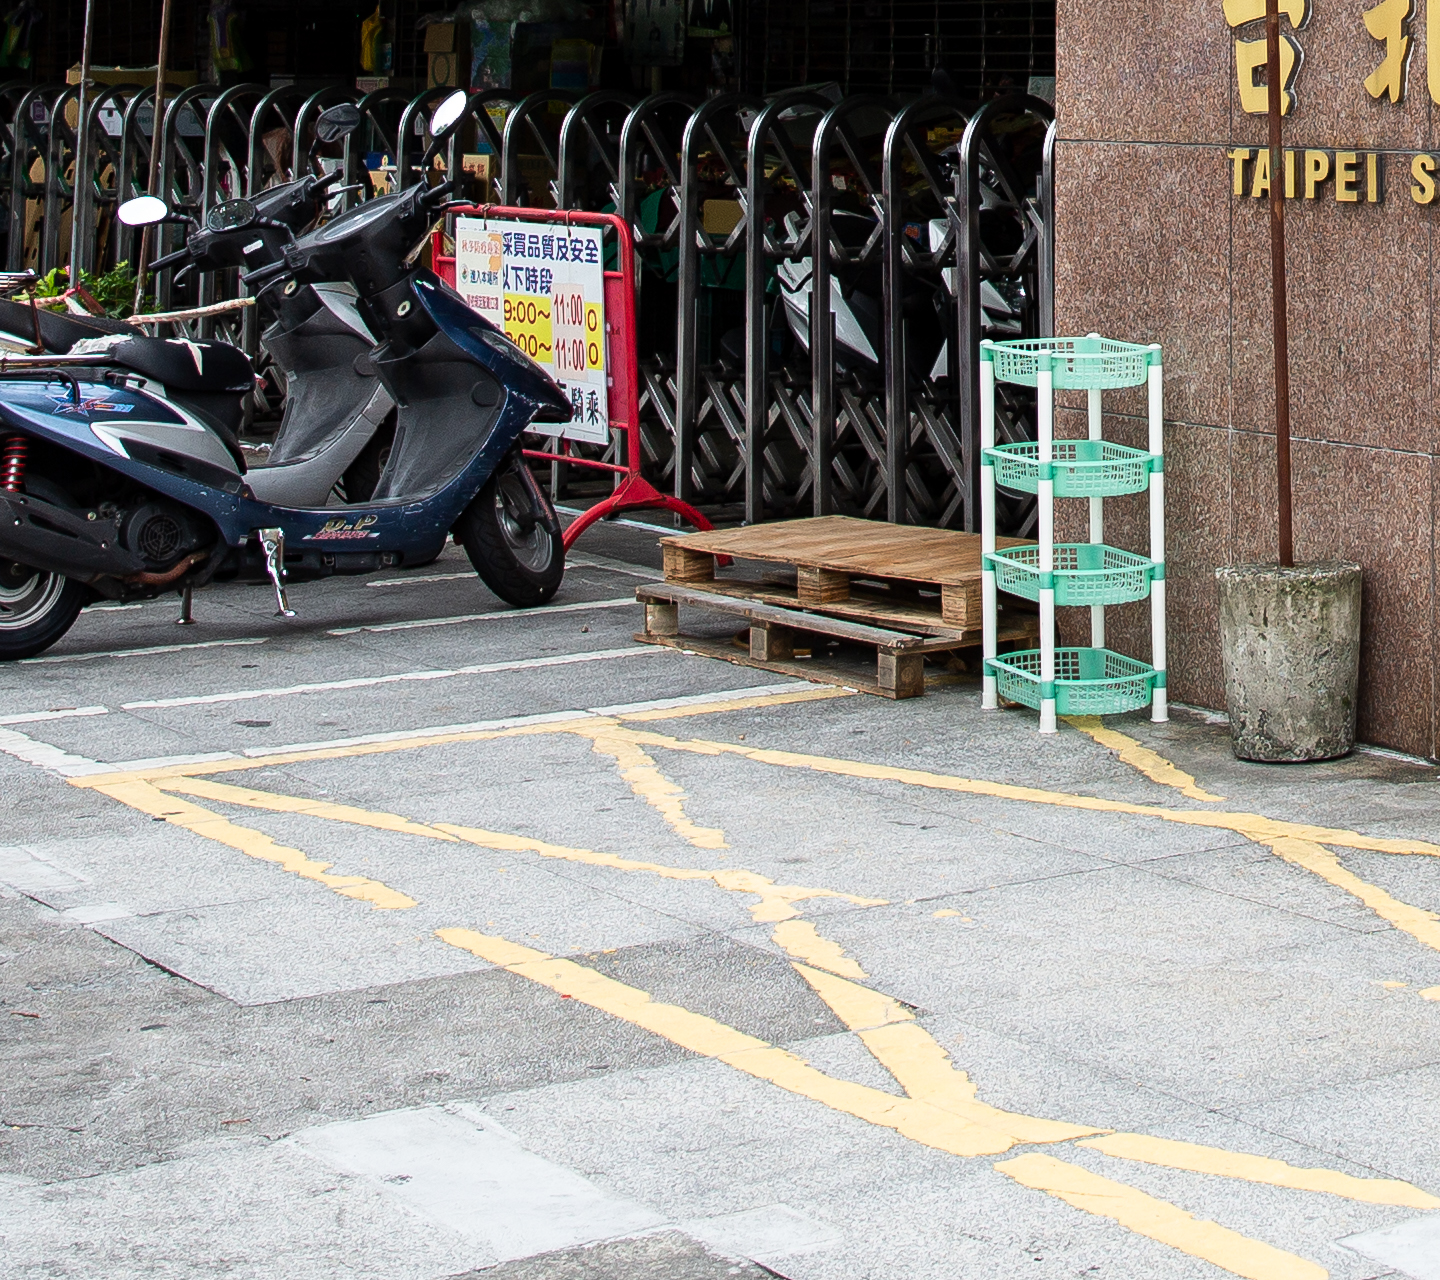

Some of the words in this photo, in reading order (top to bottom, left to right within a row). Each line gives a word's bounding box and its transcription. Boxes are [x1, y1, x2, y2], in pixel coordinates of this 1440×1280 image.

[1228, 148, 1380, 204] TAIPEI
[554, 292, 583, 327] 11:00
[555, 337, 586, 372] 11:00
